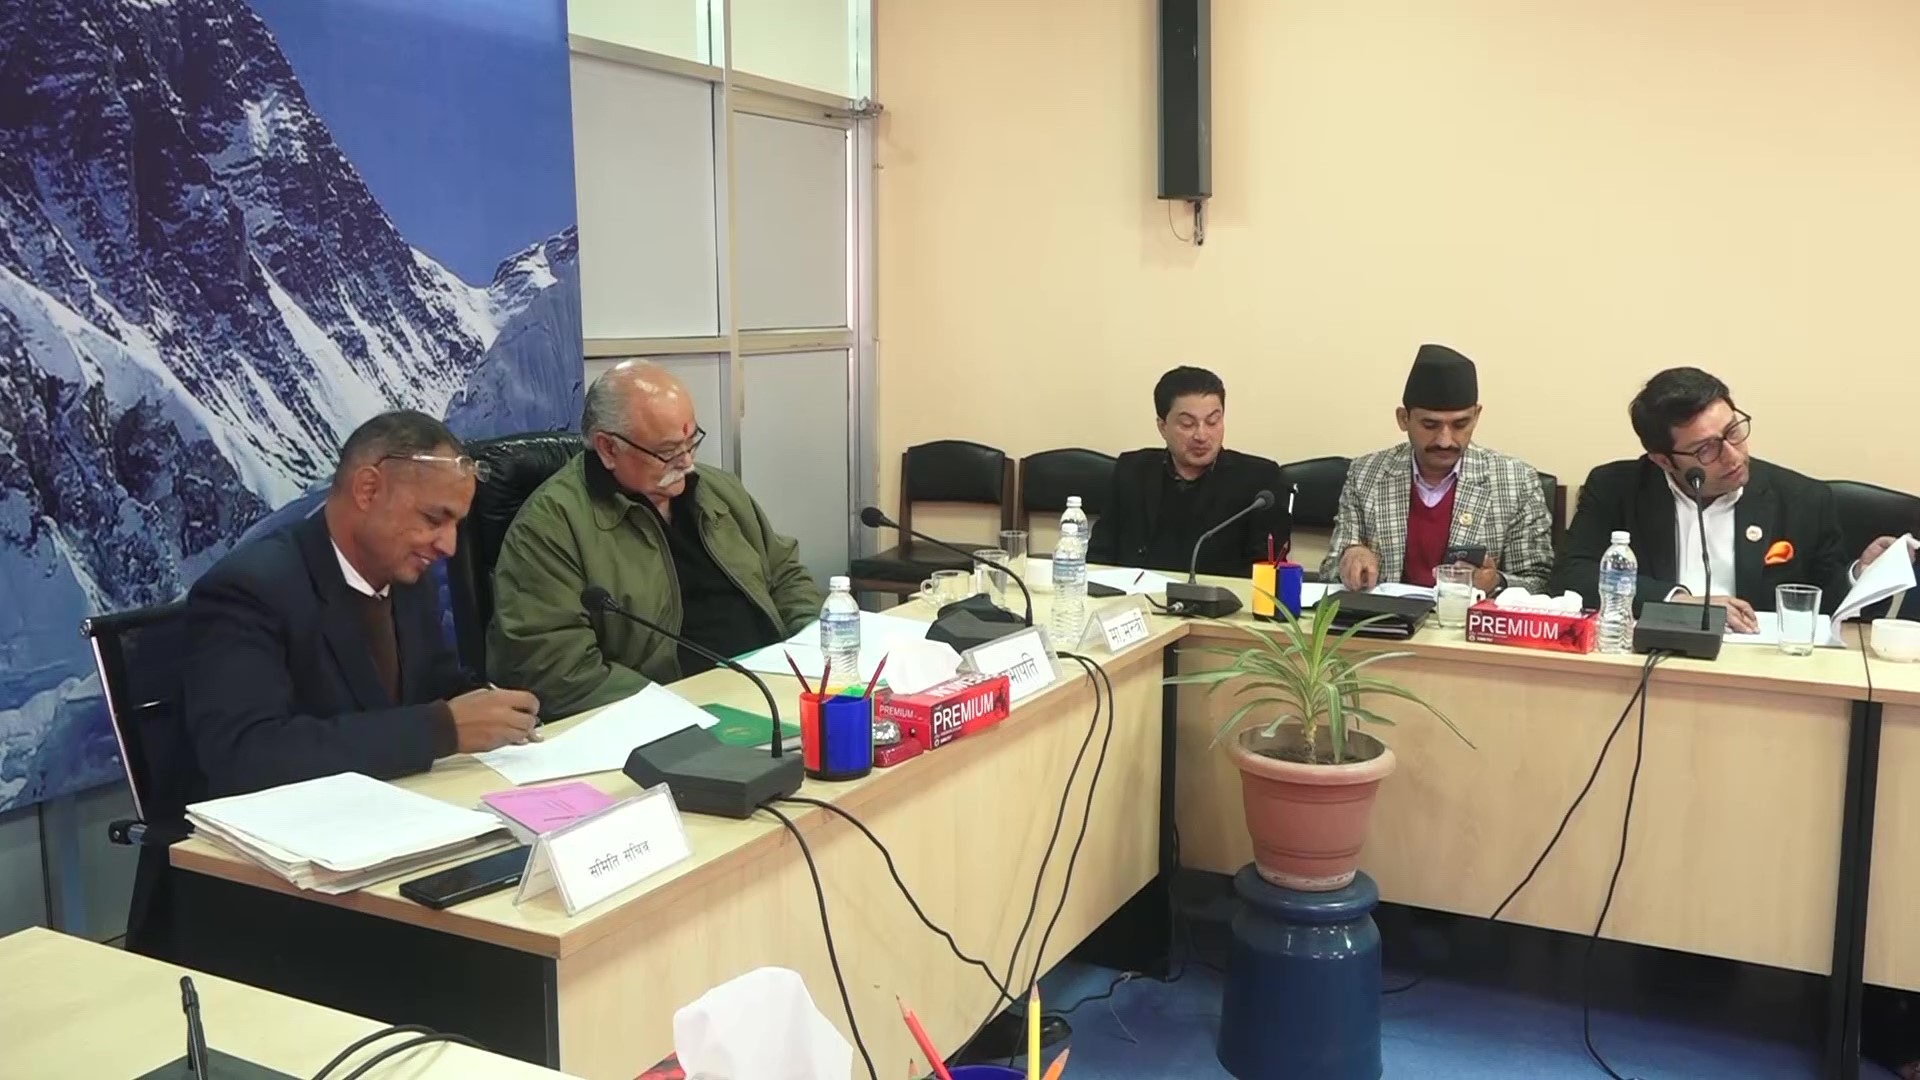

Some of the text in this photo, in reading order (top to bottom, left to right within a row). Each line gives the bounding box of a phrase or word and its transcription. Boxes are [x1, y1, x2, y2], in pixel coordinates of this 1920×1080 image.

[1469, 614, 1559, 640] PREMIUM
[1001, 652, 1039, 684] भापति
[879, 704, 914, 719] PREMIUM
[933, 691, 994, 734] PREMIUM
[589, 841, 650, 878] समिति सचिव
